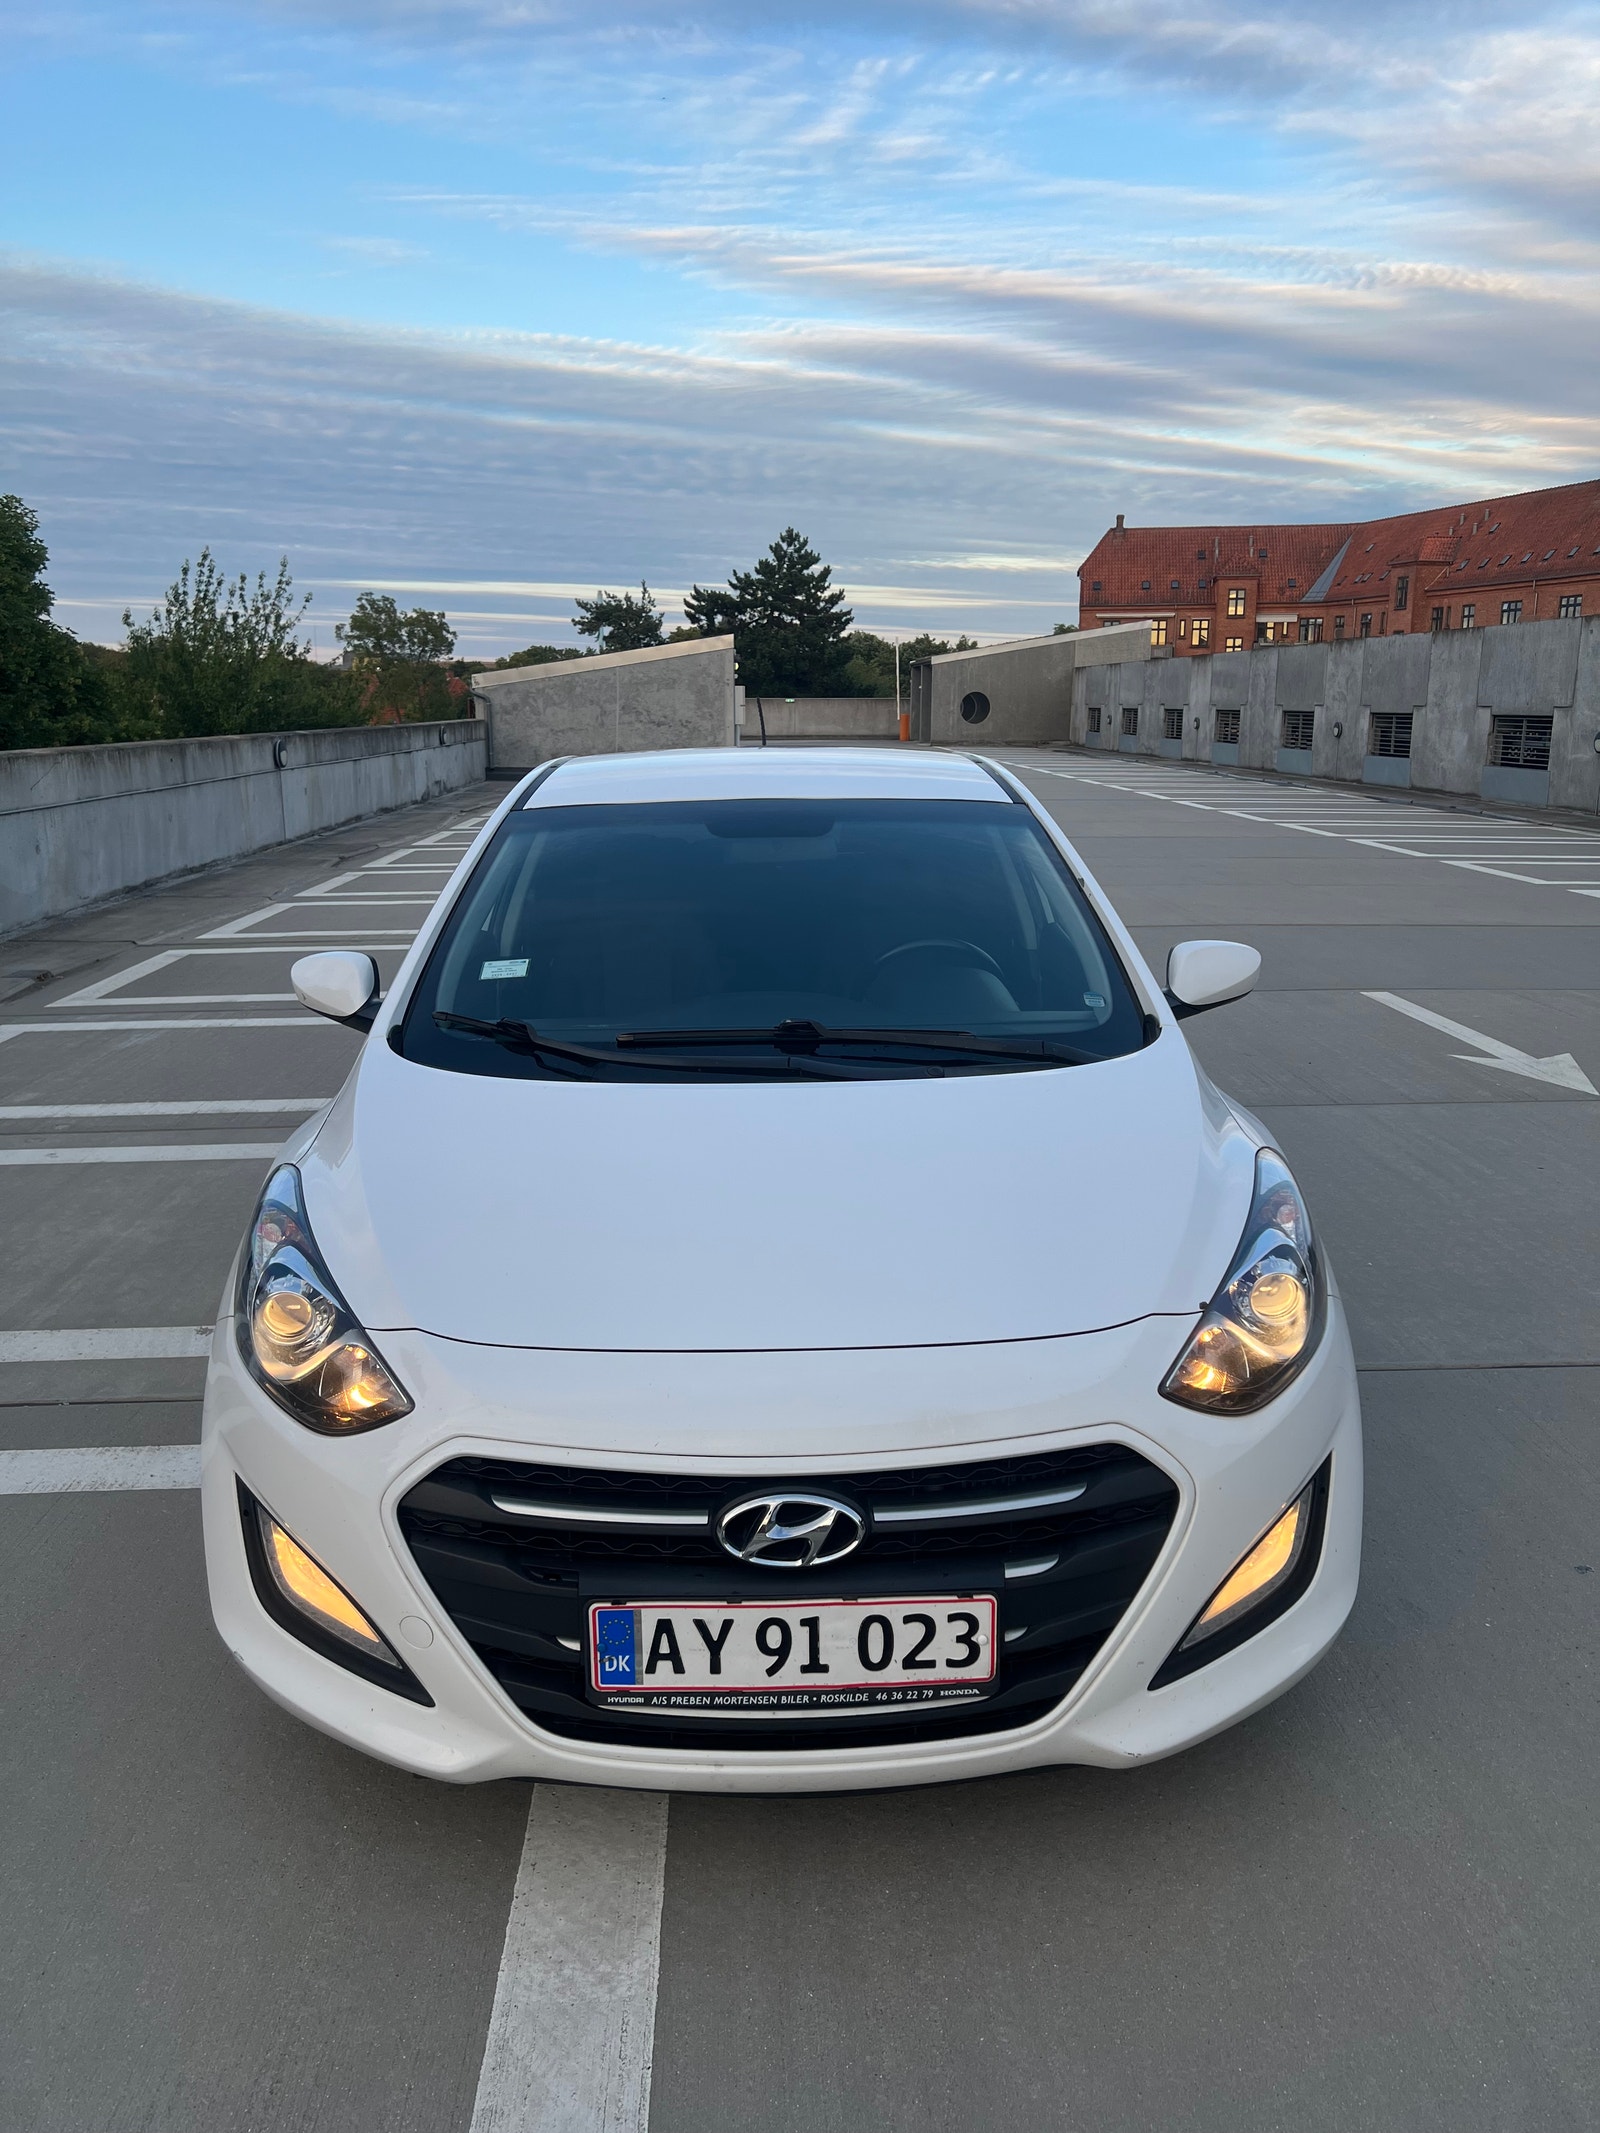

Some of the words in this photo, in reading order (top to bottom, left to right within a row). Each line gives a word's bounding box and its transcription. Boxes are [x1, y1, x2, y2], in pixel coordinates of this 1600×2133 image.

[645, 1618, 734, 1674] AY
[755, 1616, 830, 1677] 91
[857, 1612, 981, 1671] 023
[604, 1655, 631, 1672] DK
[607, 1696, 645, 1704] HYUNDAI
[651, 1696, 668, 1705] A/S
[670, 1696, 712, 1705] PREBEN
[713, 1695, 778, 1705] MORTENSEN
[781, 1694, 810, 1704] BILER
[820, 1692, 870, 1703] ROSKILDE
[876, 1691, 888, 1701] 46
[891, 1691, 903, 1700] 36
[906, 1690, 918, 1699] 22
[922, 1689, 934, 1699] 79
[939, 1688, 981, 1697] HONDA
